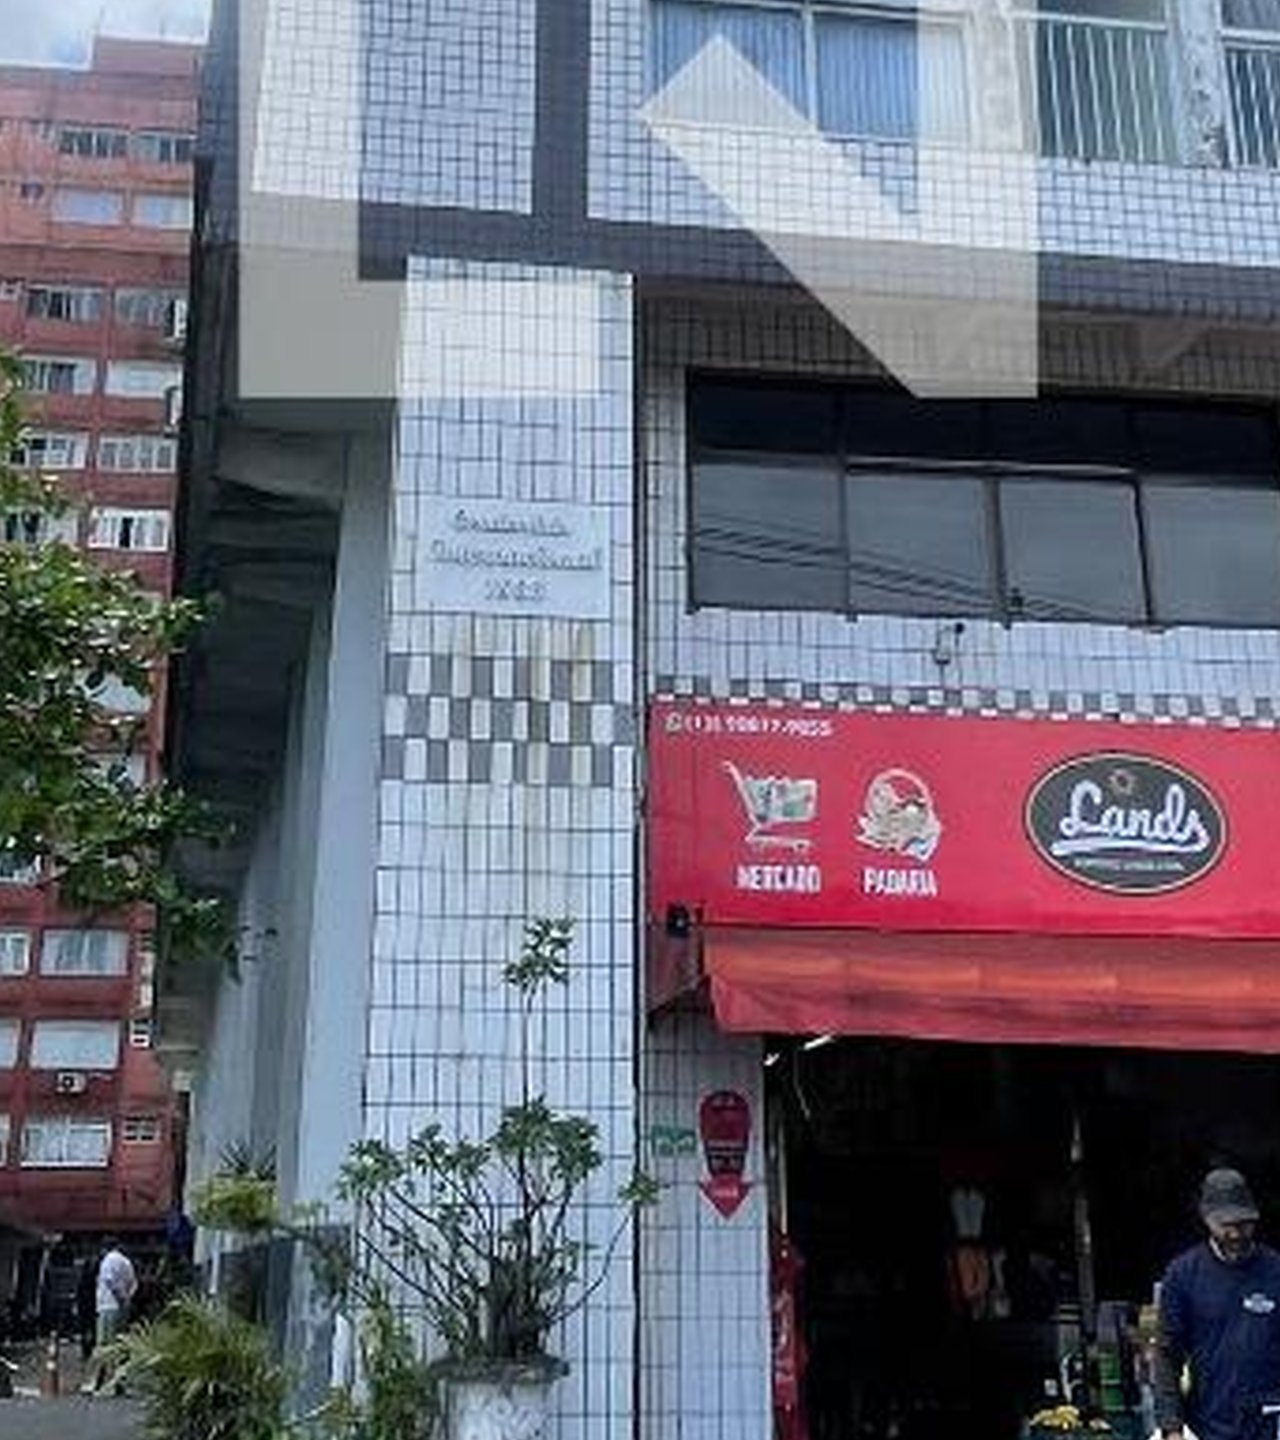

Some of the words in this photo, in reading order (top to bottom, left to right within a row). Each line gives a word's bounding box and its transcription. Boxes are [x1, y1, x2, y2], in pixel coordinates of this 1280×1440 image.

[1052, 779, 1211, 854] Lands
[735, 865, 821, 891] MERCADO
[863, 867, 939, 896] PADARIA
